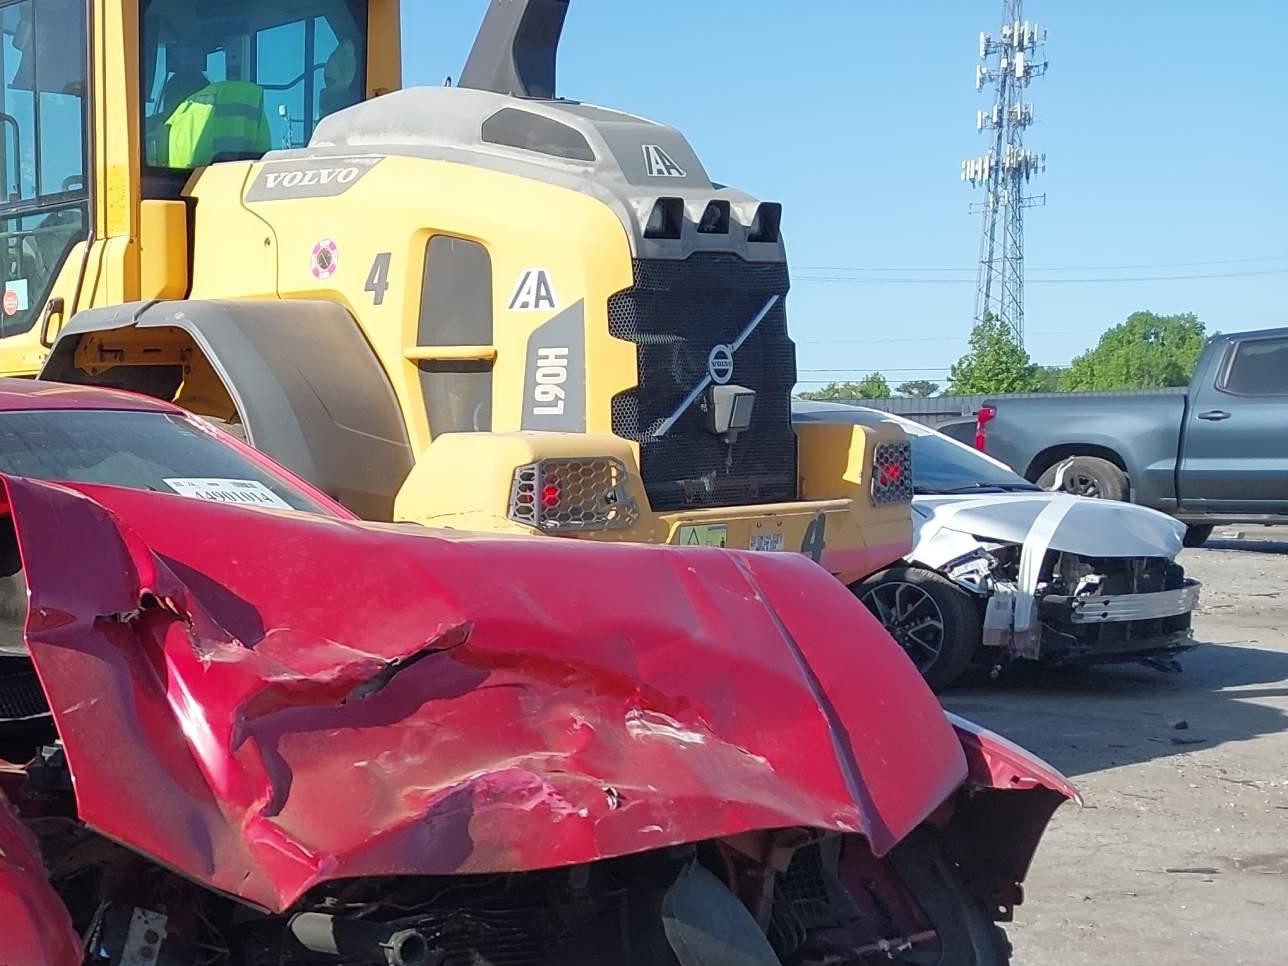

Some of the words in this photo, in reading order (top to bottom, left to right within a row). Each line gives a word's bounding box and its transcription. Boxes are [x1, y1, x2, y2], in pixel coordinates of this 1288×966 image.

[265, 167, 359, 188] VOLVO
[364, 252, 392, 305] 4
[533, 347, 569, 415] L90H
[801, 512, 826, 564] 4
